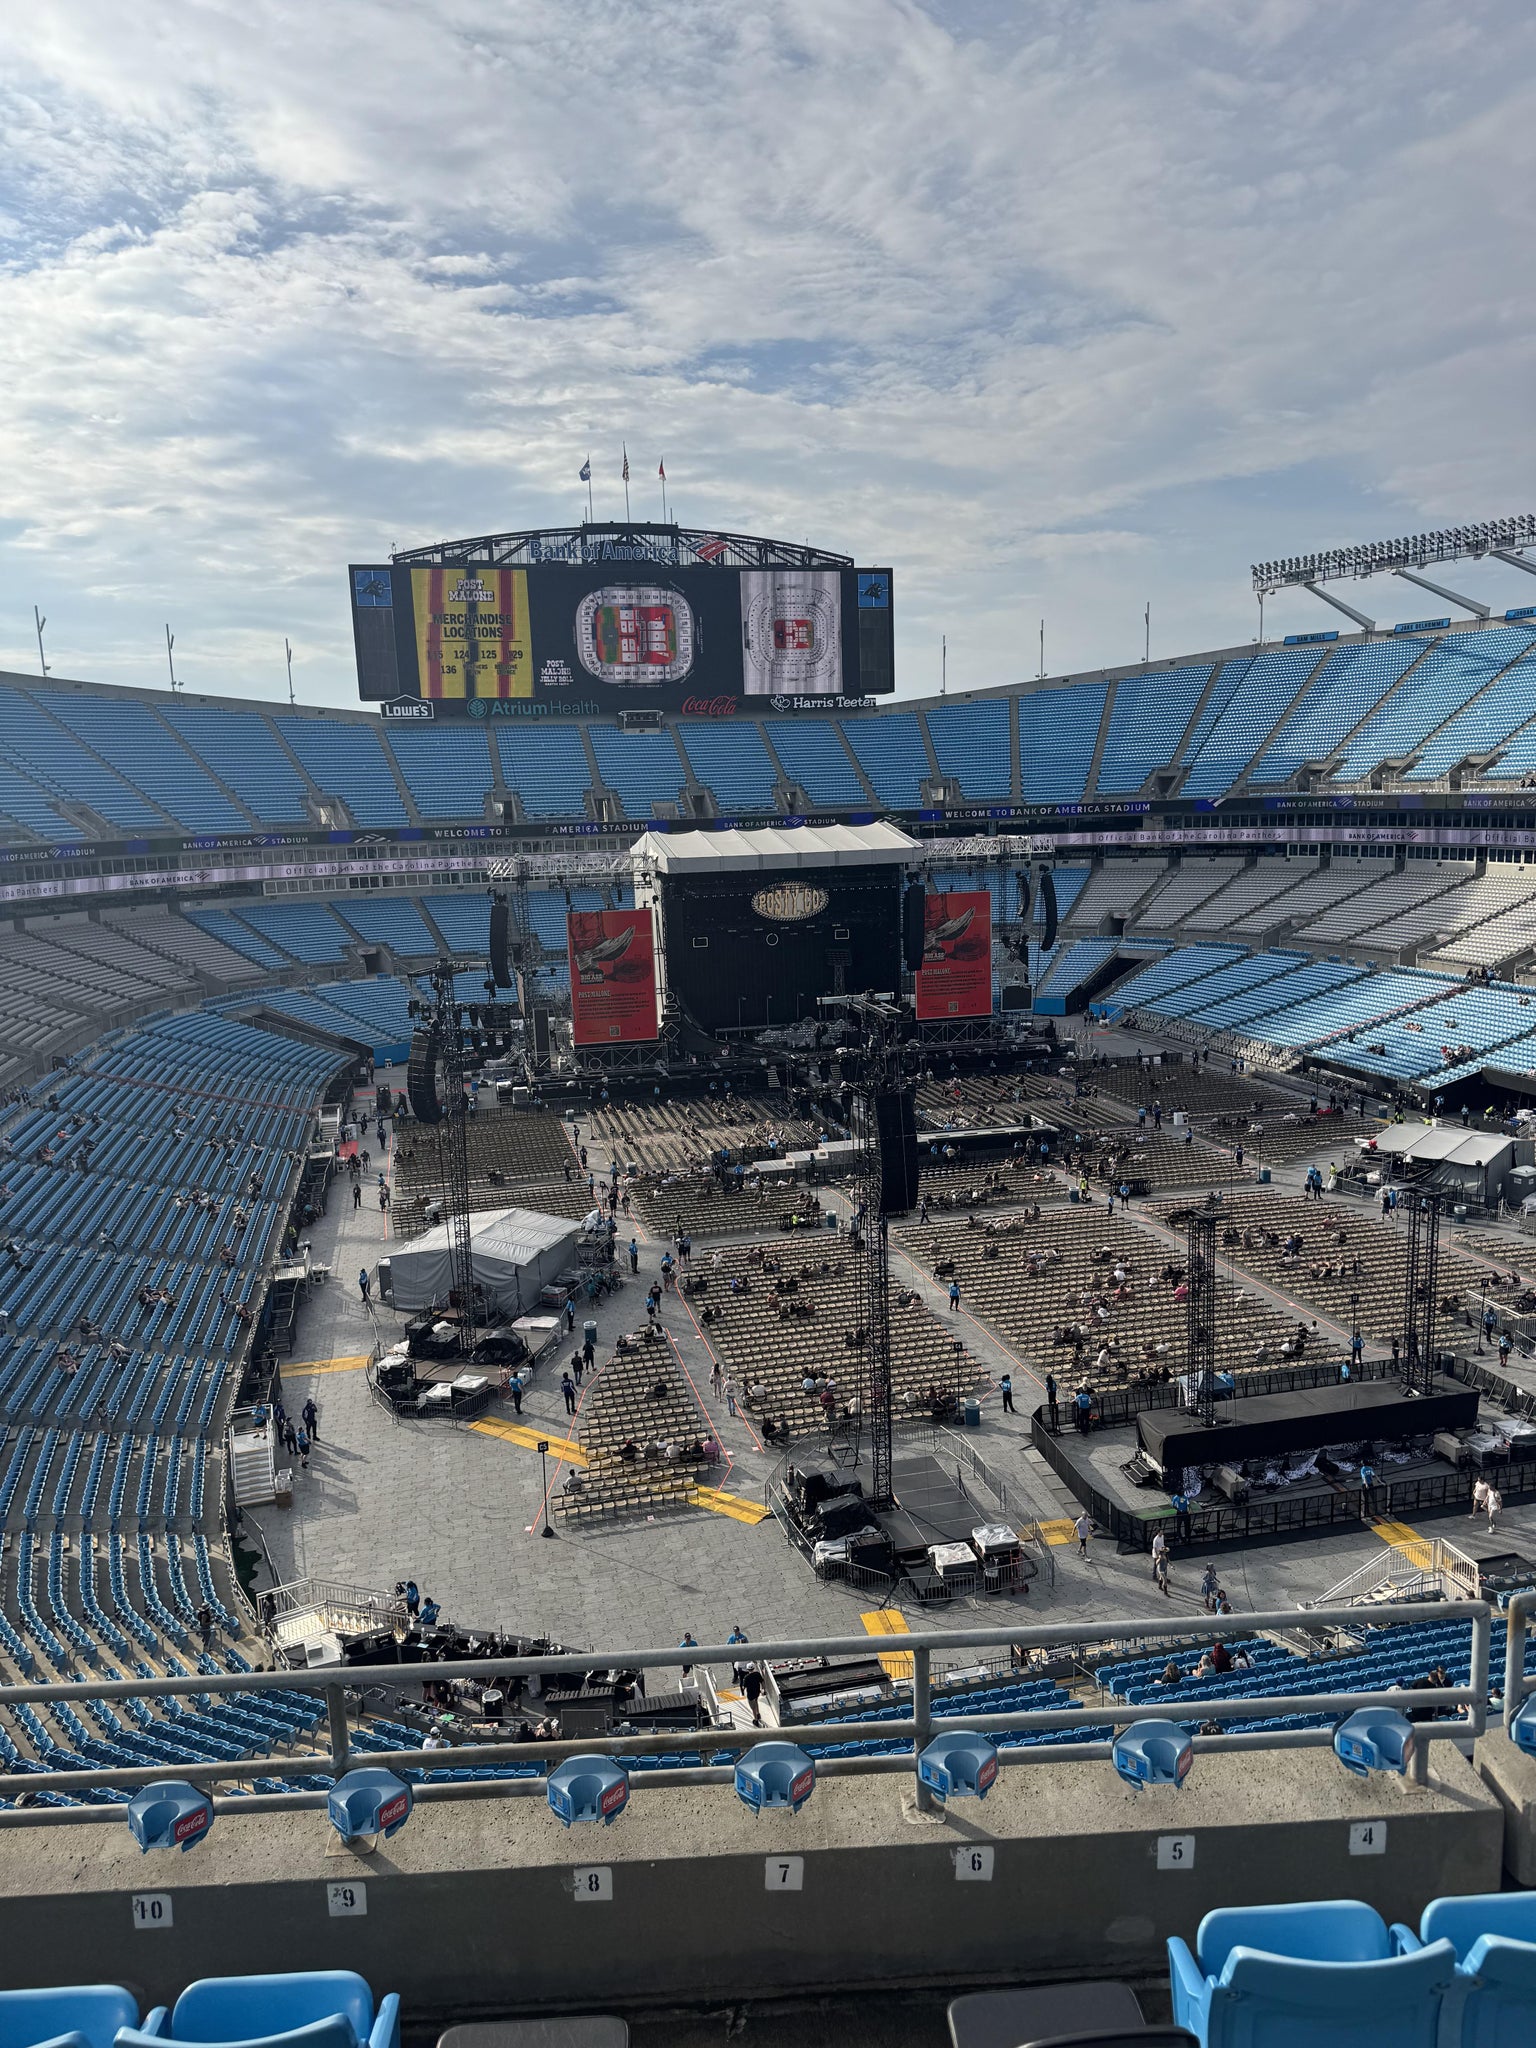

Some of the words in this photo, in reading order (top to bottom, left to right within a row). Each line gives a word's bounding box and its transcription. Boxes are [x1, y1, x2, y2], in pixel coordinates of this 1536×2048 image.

[530, 540, 577, 560] Bank
[581, 541, 600, 560] of
[602, 540, 679, 560] America
[457, 579, 484, 590] POST
[448, 590, 494, 602] MALONE
[432, 614, 512, 625] MERCHANDISE
[444, 626, 504, 638] LOCATIONS
[481, 650, 497, 659] 125
[440, 665, 456, 674] 136
[546, 660, 564, 668] POST
[491, 700, 548, 716] Atrium
[550, 700, 600, 714] Health
[793, 697, 834, 708] Harris
[836, 696, 876, 708] Teeter
[386, 704, 428, 716] LOWE'S
[945, 810, 992, 818] WELCOME
[1054, 806, 1100, 814] AMERICA
[1104, 803, 1150, 812] STADIUM
[434, 828, 485, 838] WELCOME
[490, 828, 502, 836] TO
[552, 825, 598, 834] AMERICA
[602, 823, 649, 832] STADIUM
[1485, 834, 1521, 842] Official
[216, 839, 252, 848] AMERICA
[271, 837, 308, 845] STADIUM
[62, 848, 95, 857] STADIUM
[286, 865, 328, 875] Official
[331, 864, 355, 873] Bank
[359, 864, 369, 872] of
[373, 862, 389, 871] the
[392, 860, 435, 870] Carolina
[438, 859, 483, 868] Panthers
[16, 886, 58, 898] Panthers
[382, 1799, 406, 1822] Coca-Cola
[177, 1813, 204, 1836] Coca-Cola
[1362, 1827, 1373, 1845] 4
[1172, 1842, 1183, 1860] 5
[972, 1853, 982, 1871] 6
[779, 1864, 789, 1883] 7
[588, 1874, 600, 1892] 8
[343, 1889, 355, 1907] 9
[140, 1900, 162, 1919] 10
